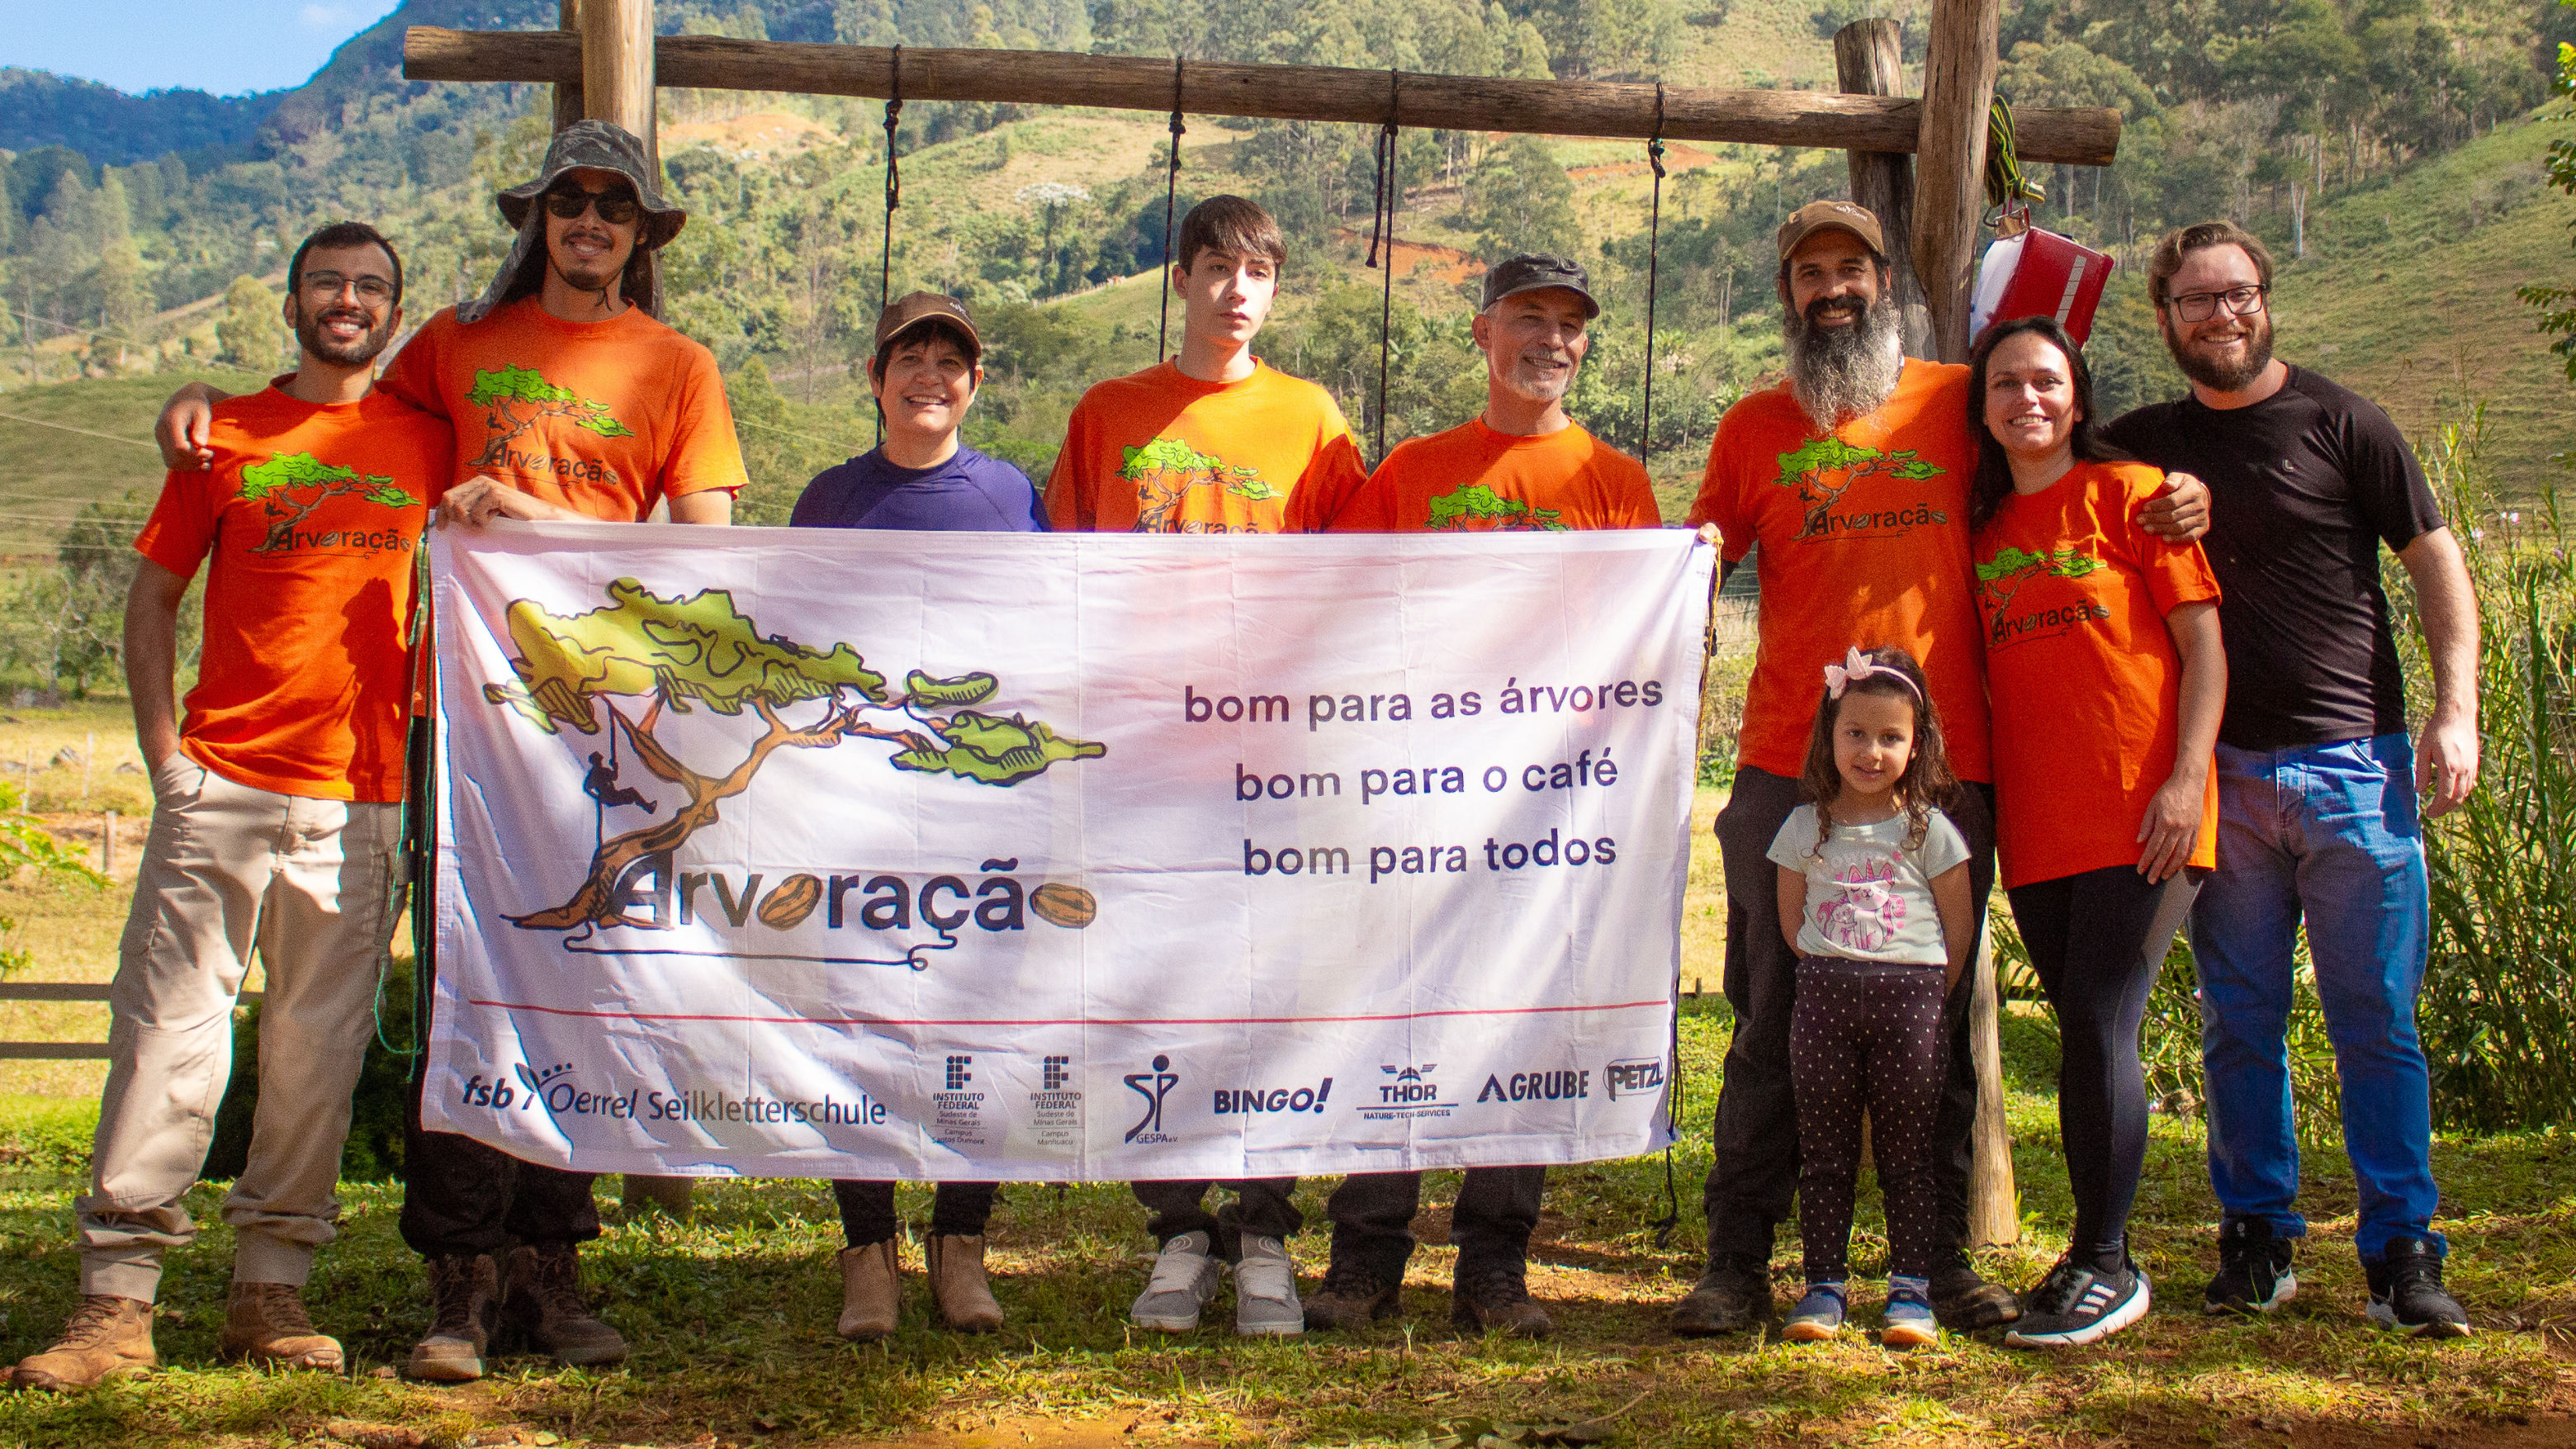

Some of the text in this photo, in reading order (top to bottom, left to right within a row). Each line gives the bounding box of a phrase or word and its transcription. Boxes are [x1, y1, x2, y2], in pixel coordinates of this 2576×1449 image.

[1184, 676, 1664, 732] bom para as árvores
[1235, 746, 1619, 805] bom para o café
[1243, 827, 1617, 884] bom para todos
[605, 850, 1096, 936] Arvoração
[1215, 1077, 1333, 1114] BINGO!
[1380, 1084, 1437, 1103] THOR
[1607, 1061, 1664, 1103] PETZL
[463, 1076, 887, 1125] fsb Oerrel Seilkletterschule
[933, 1093, 984, 1101] INSTITUTO
[938, 1101, 980, 1110] FEDERAL
[1030, 1092, 1082, 1101] INSTITUTO
[1035, 1101, 1077, 1110] FEDERAL
[945, 1129, 973, 1137] Campus
[1136, 1134, 1167, 1144] GESPA
